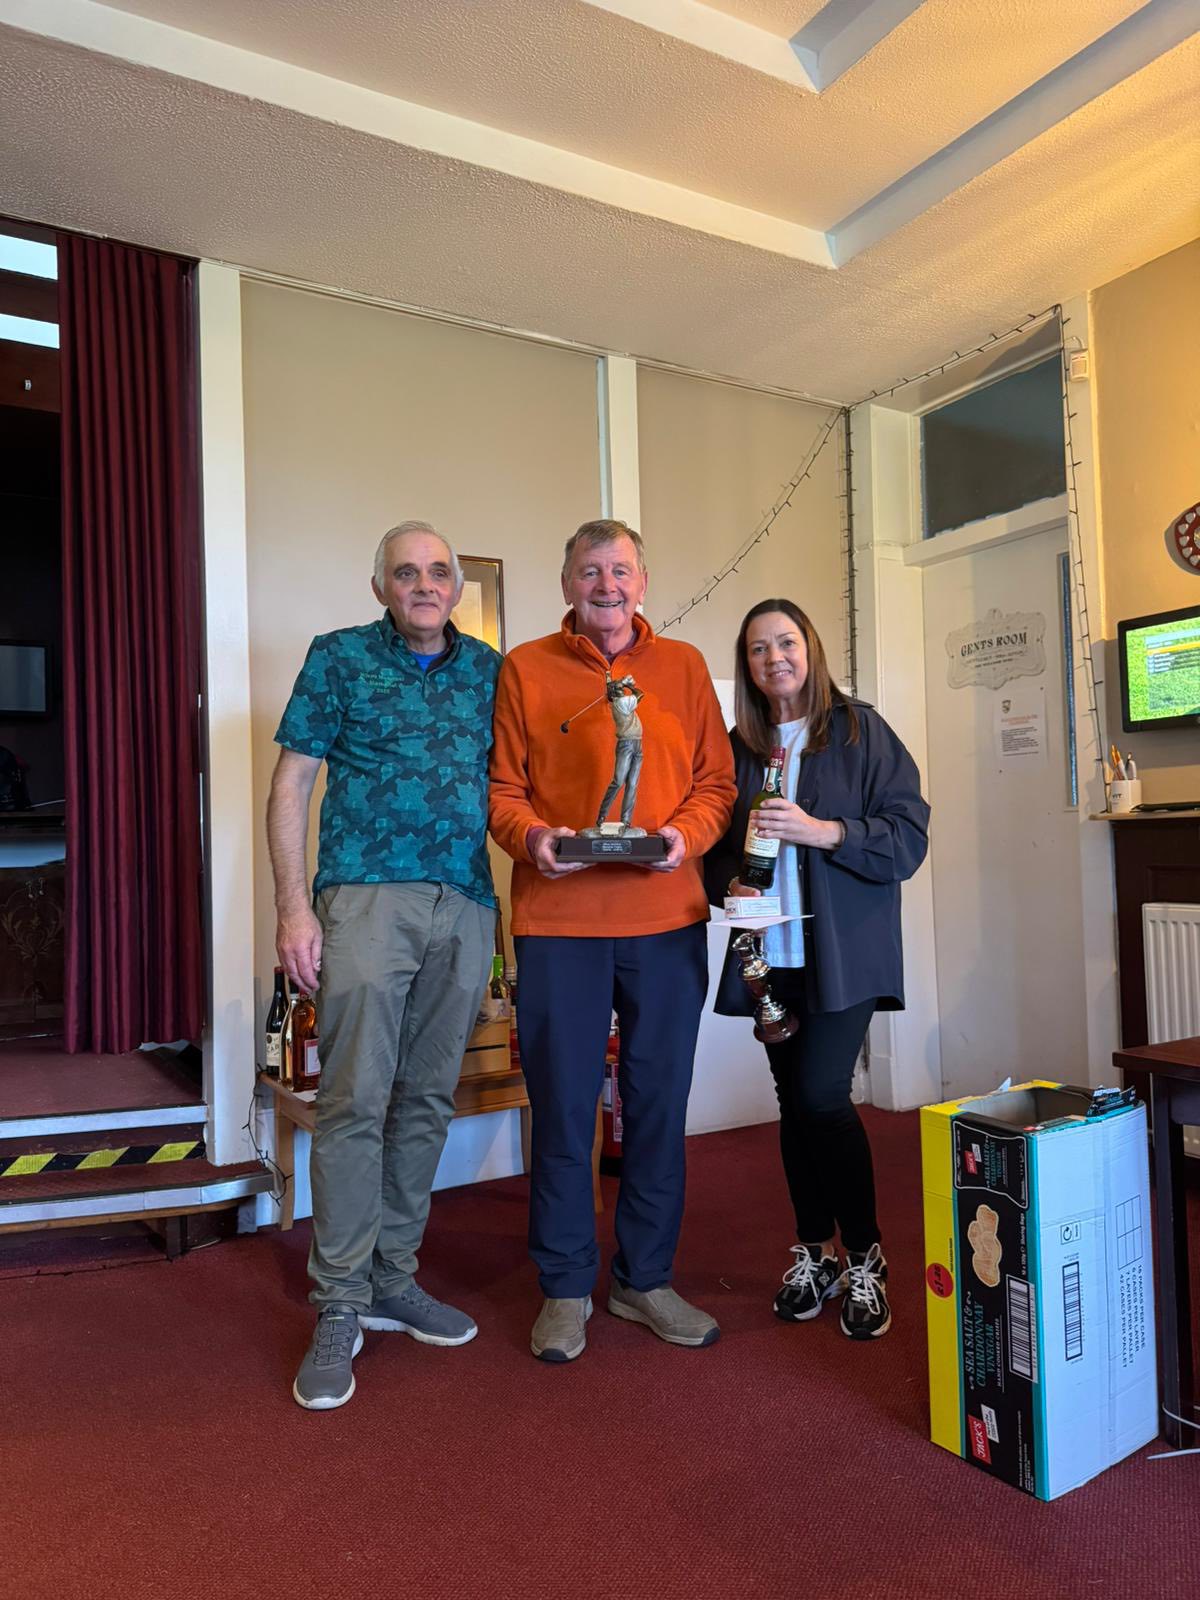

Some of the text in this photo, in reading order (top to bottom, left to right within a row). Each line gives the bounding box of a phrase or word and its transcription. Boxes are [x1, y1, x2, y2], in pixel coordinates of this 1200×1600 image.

[961, 632, 1027, 656] GENTS ROOM
[963, 1306, 975, 1374] SEA SALT &
[974, 1302, 986, 1387] CHARDONNAY
[986, 1324, 995, 1373] VINEGAR
[973, 1421, 986, 1458] JACK'S
